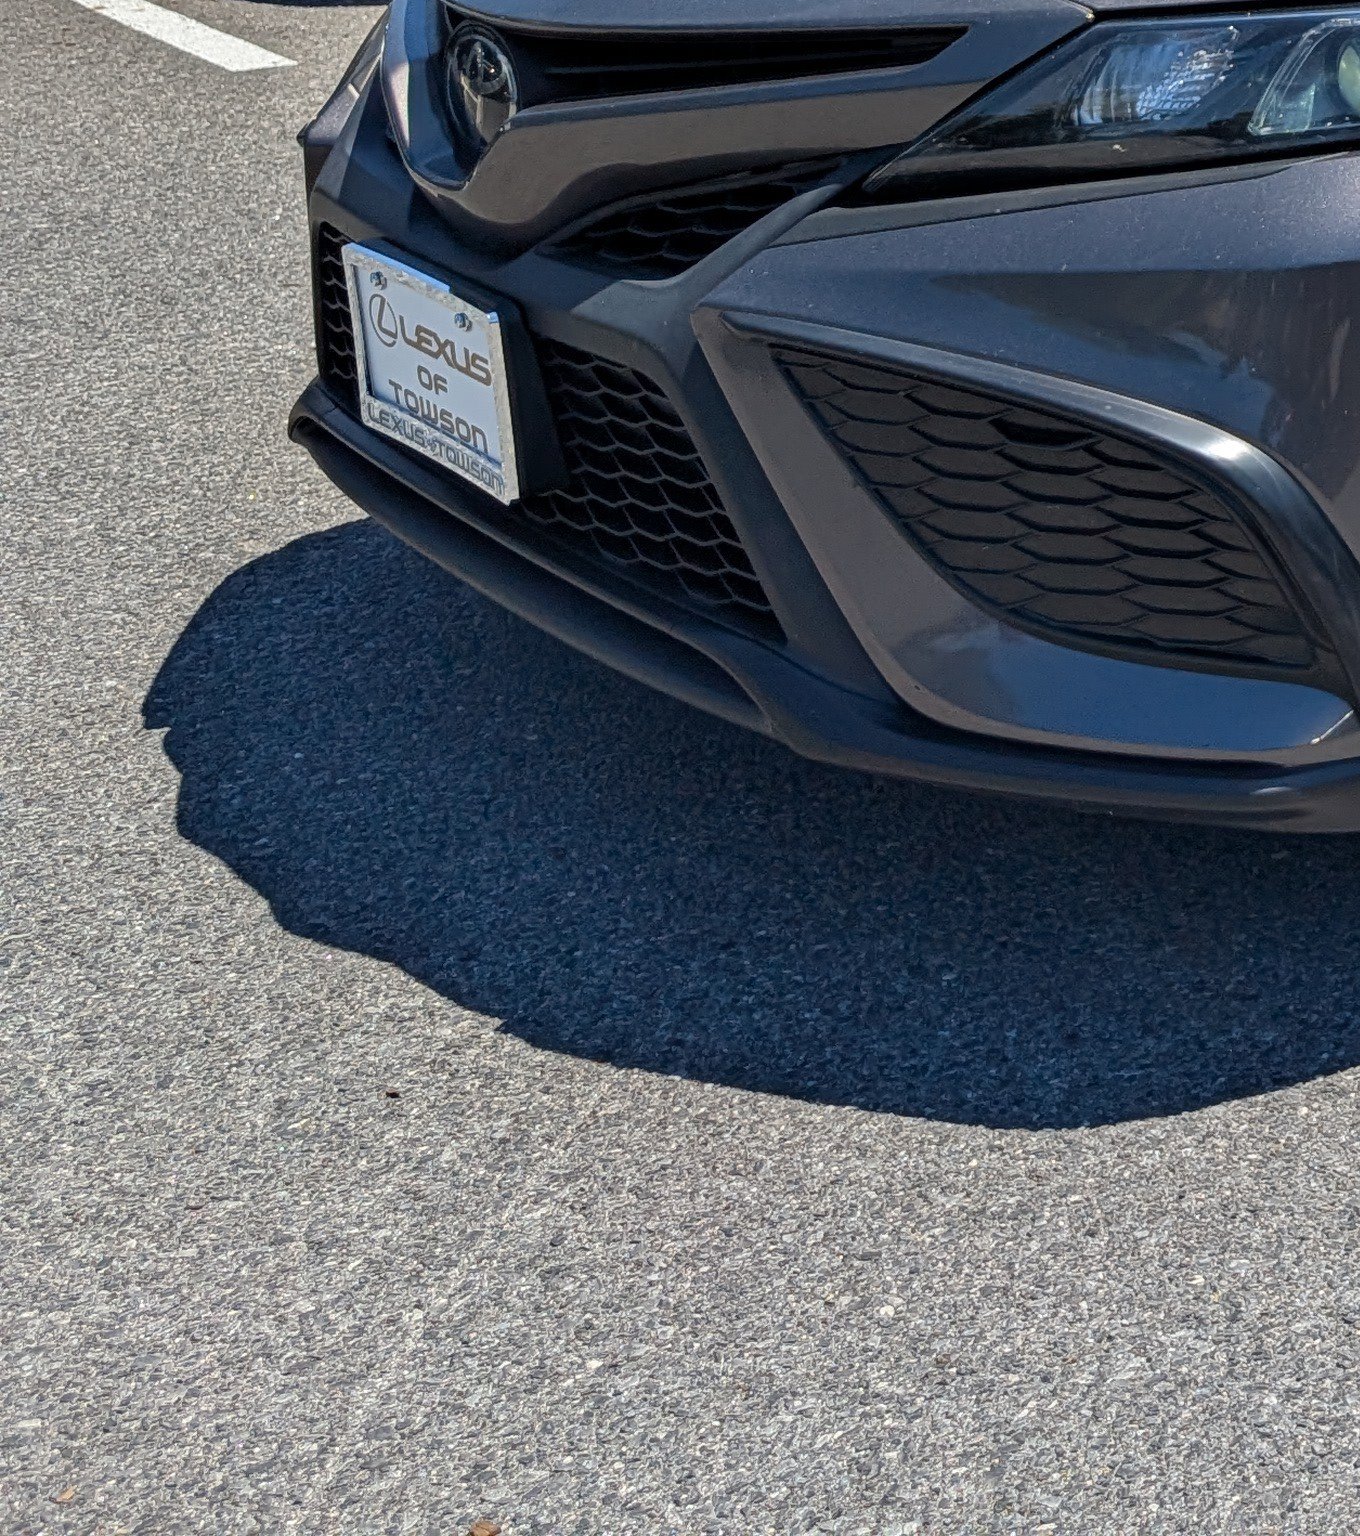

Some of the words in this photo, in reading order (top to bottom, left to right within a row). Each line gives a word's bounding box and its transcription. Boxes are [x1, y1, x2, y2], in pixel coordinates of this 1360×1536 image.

[398, 314, 491, 386] LEXUS
[416, 364, 449, 396] OF
[369, 406, 426, 448] LEXUS
